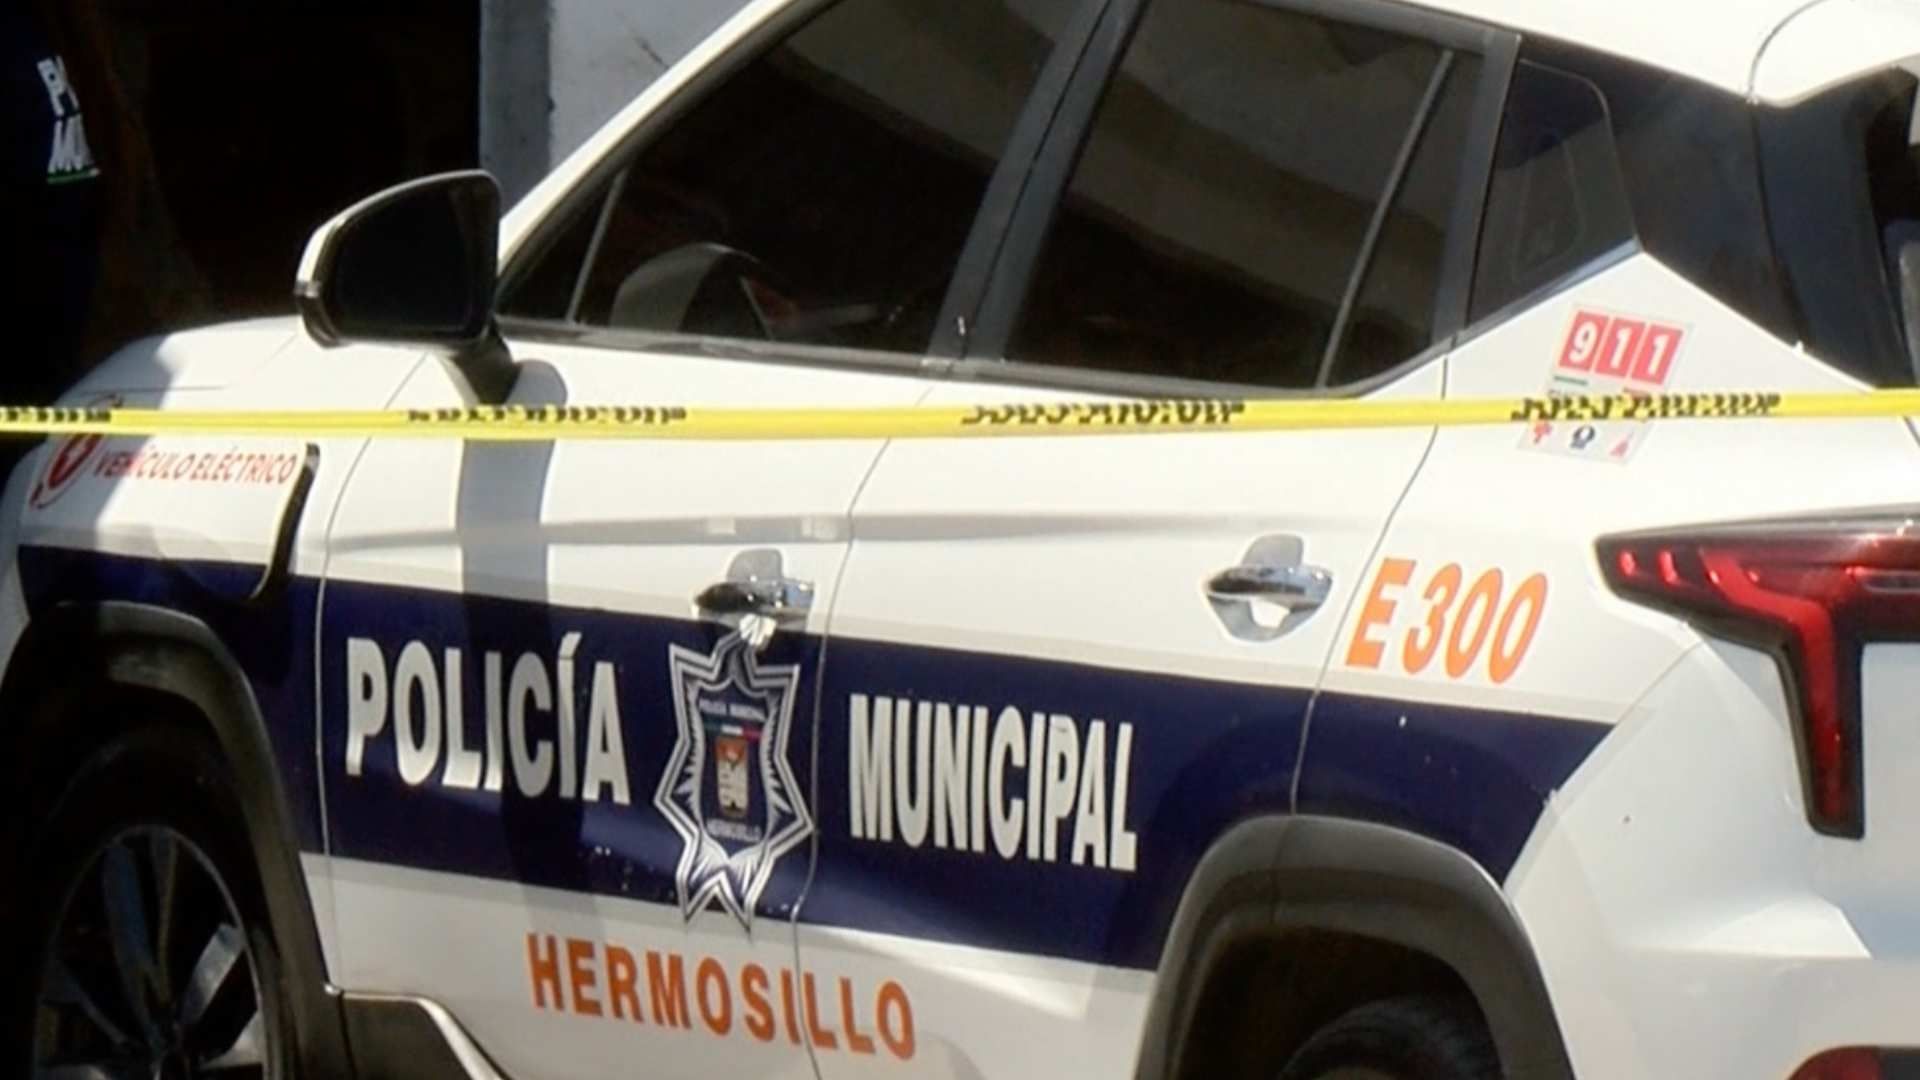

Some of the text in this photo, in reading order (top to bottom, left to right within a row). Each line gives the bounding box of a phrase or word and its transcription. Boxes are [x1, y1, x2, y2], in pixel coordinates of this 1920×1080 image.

[1568, 320, 1669, 376] 911
[191, 446, 299, 485] ELÉCTRICO
[1345, 557, 1548, 684] E 300
[346, 632, 1137, 872] POLICÍA MUNICIPAL
[526, 932, 916, 1061] HERMOSILLO
